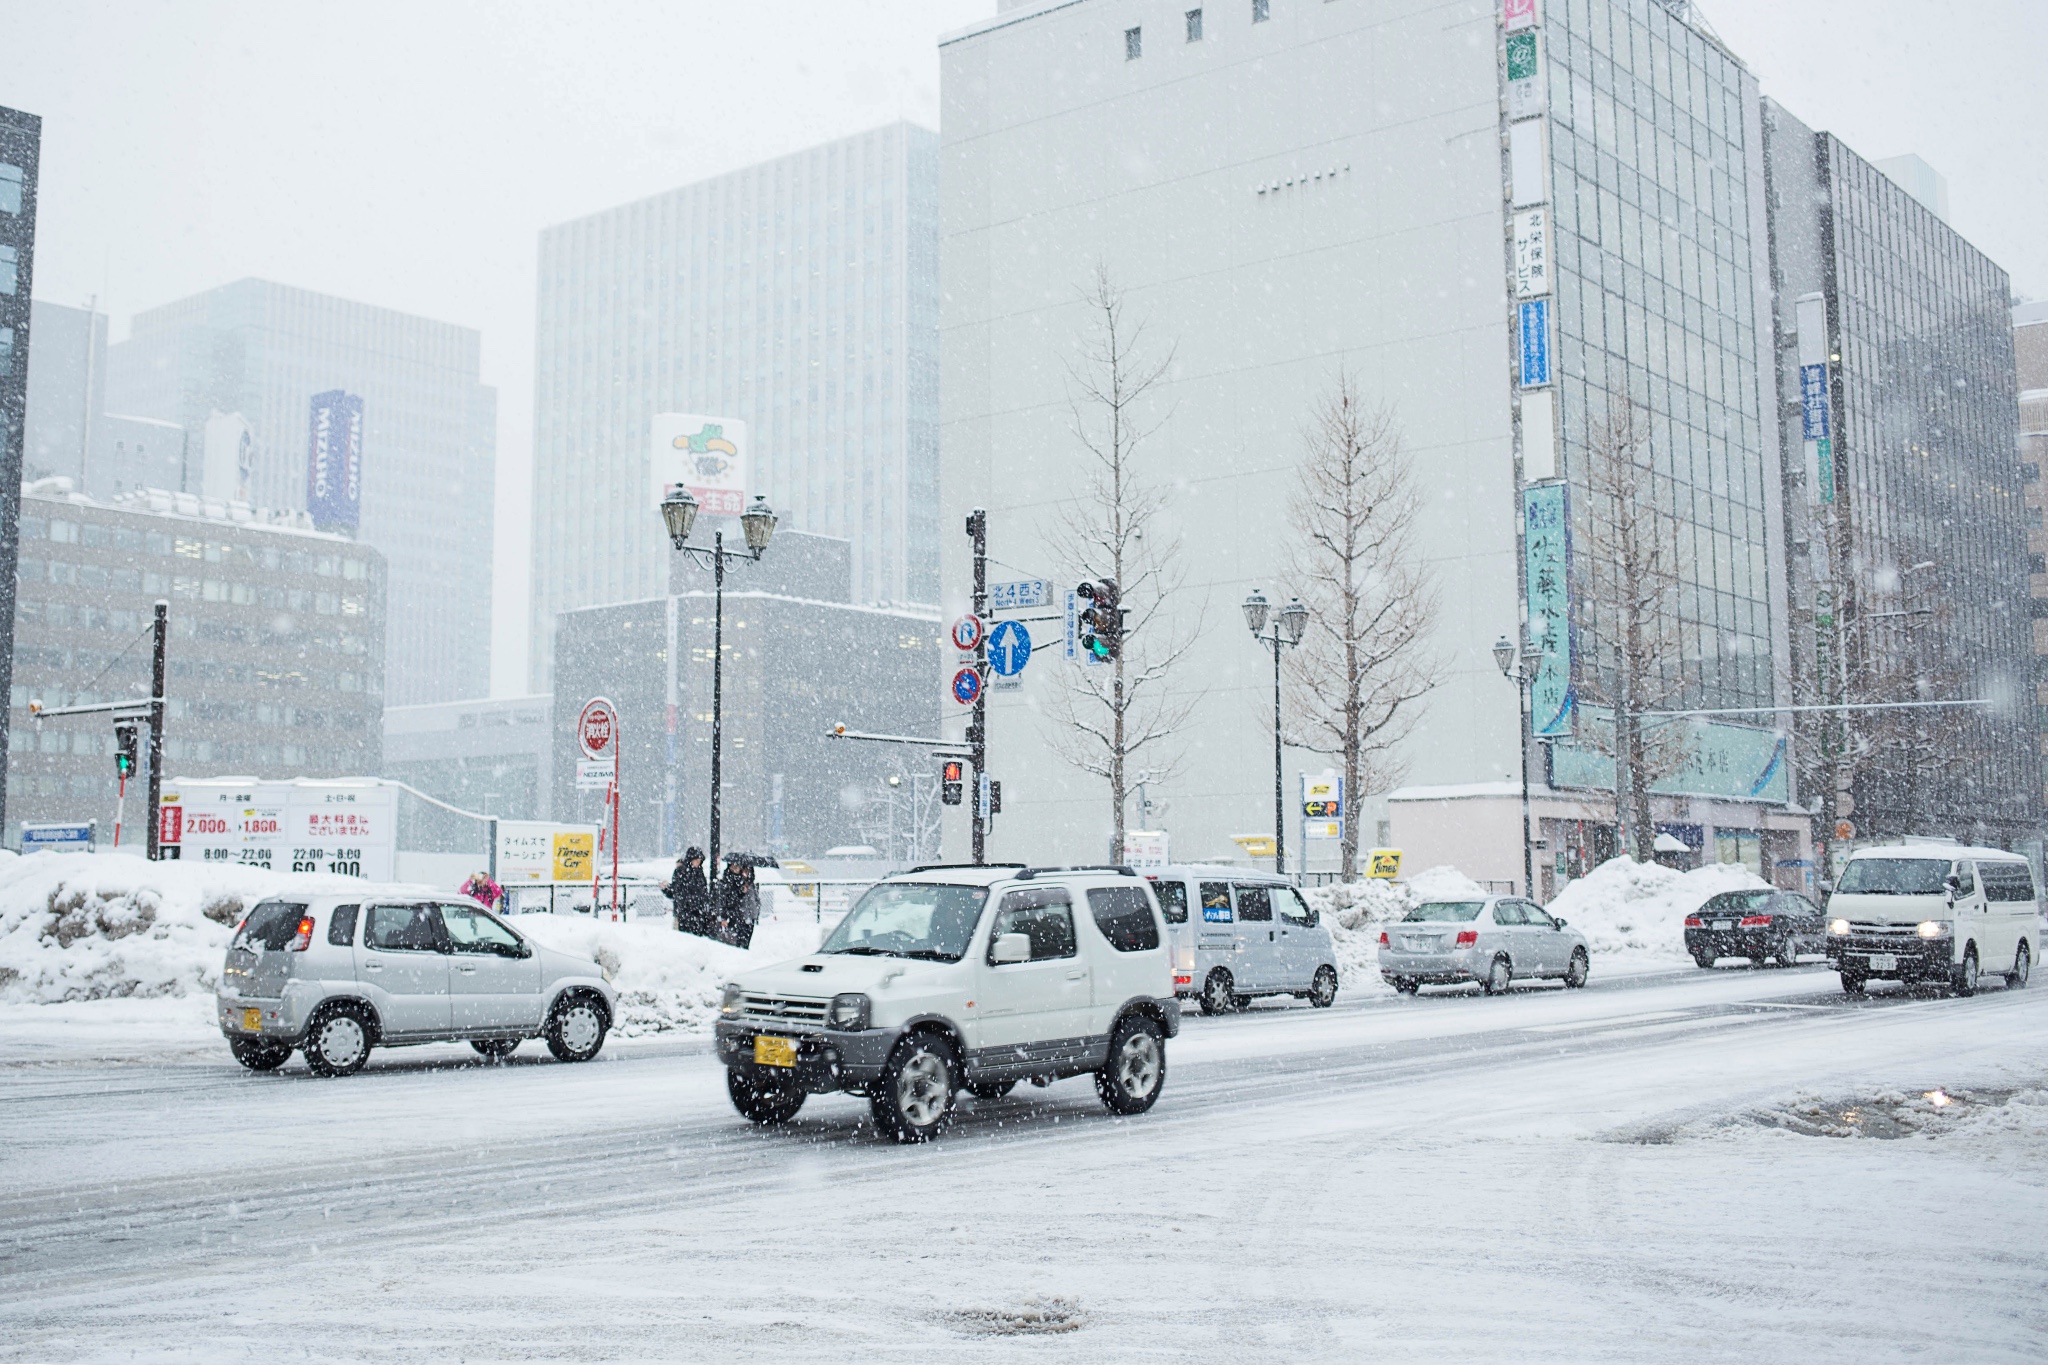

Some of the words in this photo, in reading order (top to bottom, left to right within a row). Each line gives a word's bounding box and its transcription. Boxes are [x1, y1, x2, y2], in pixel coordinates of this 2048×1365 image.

[1517, 239, 1531, 294] サービス
[316, 407, 331, 498] MIZUHO
[348, 410, 361, 501] MIZUHO
[587, 722, 609, 739] 消火栓
[556, 847, 590, 858] Times
[563, 859, 582, 868] Car
